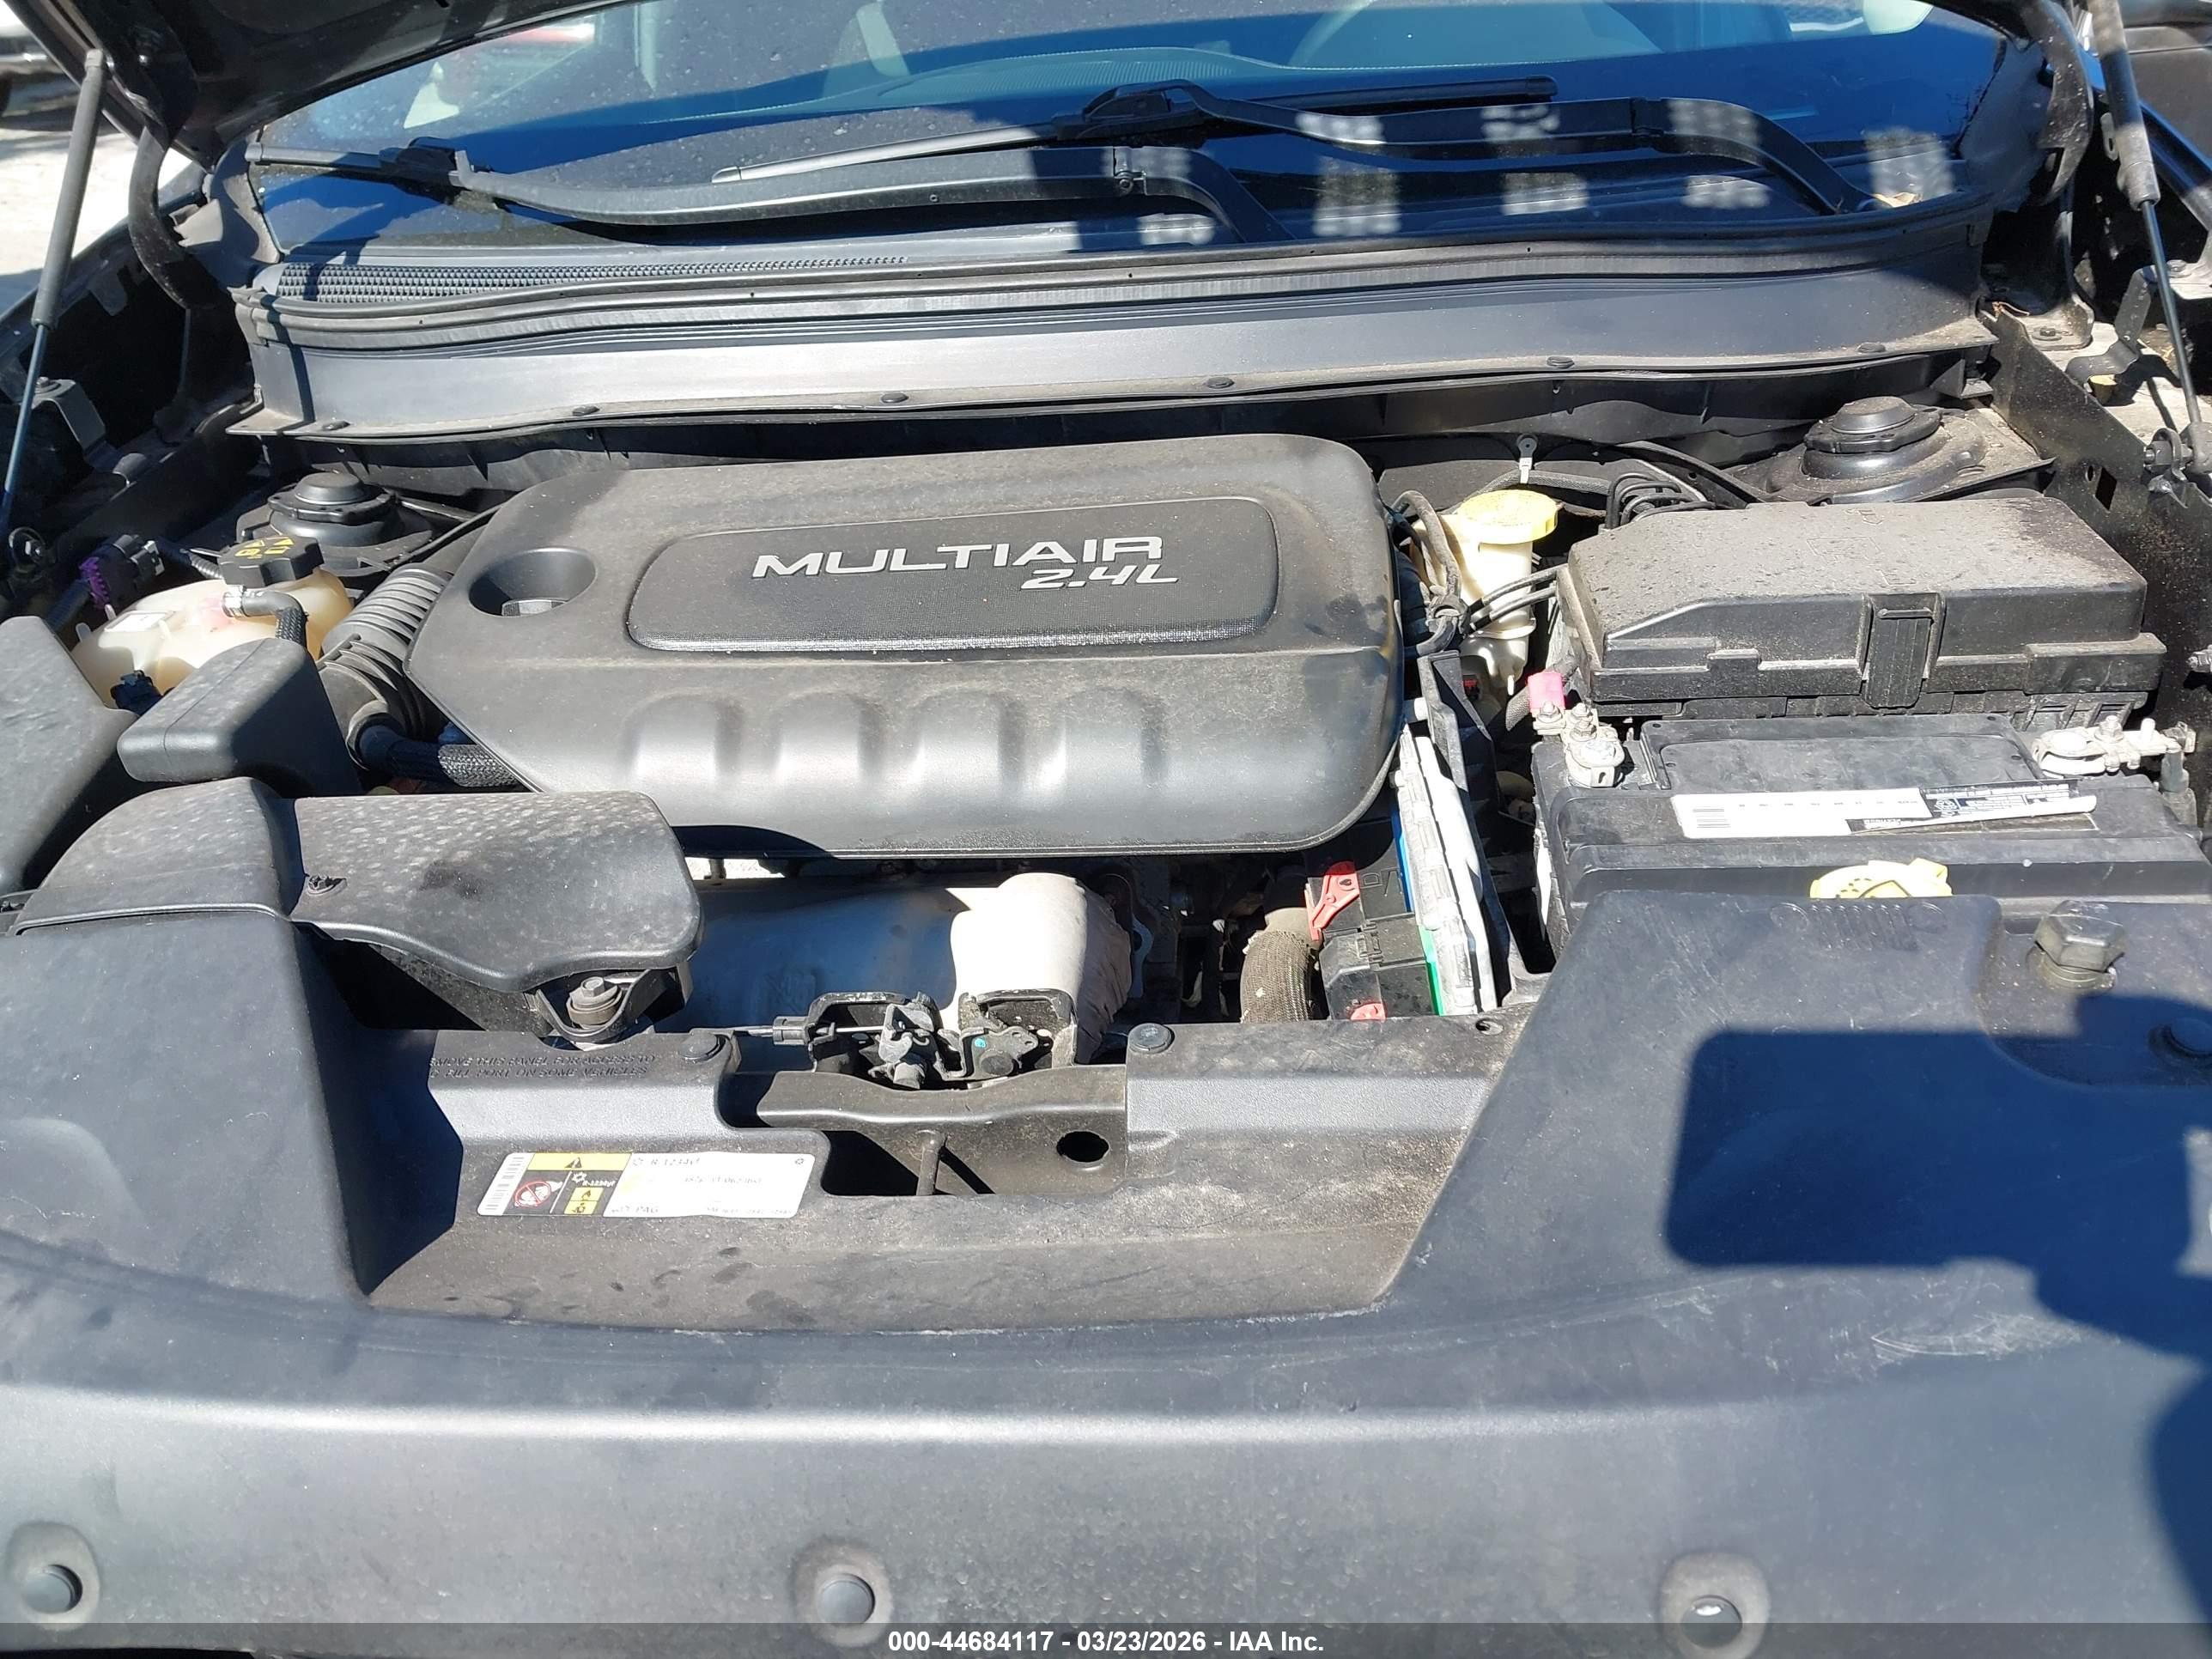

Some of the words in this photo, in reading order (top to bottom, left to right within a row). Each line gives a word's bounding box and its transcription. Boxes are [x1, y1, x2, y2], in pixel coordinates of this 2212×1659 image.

[751, 536, 1164, 579] MULTIAIR
[1020, 563, 1179, 590] 2.4L
[428, 1057, 473, 1066] EMOVE
[476, 1057, 506, 1066] THIS
[507, 1057, 549, 1066] PANEL
[583, 1055, 635, 1065] ACCESS
[475, 1069, 509, 1079] PORT
[515, 1068, 537, 1079] ON
[538, 1067, 577, 1078] SOME
[582, 1066, 647, 1078] VEHICLES
